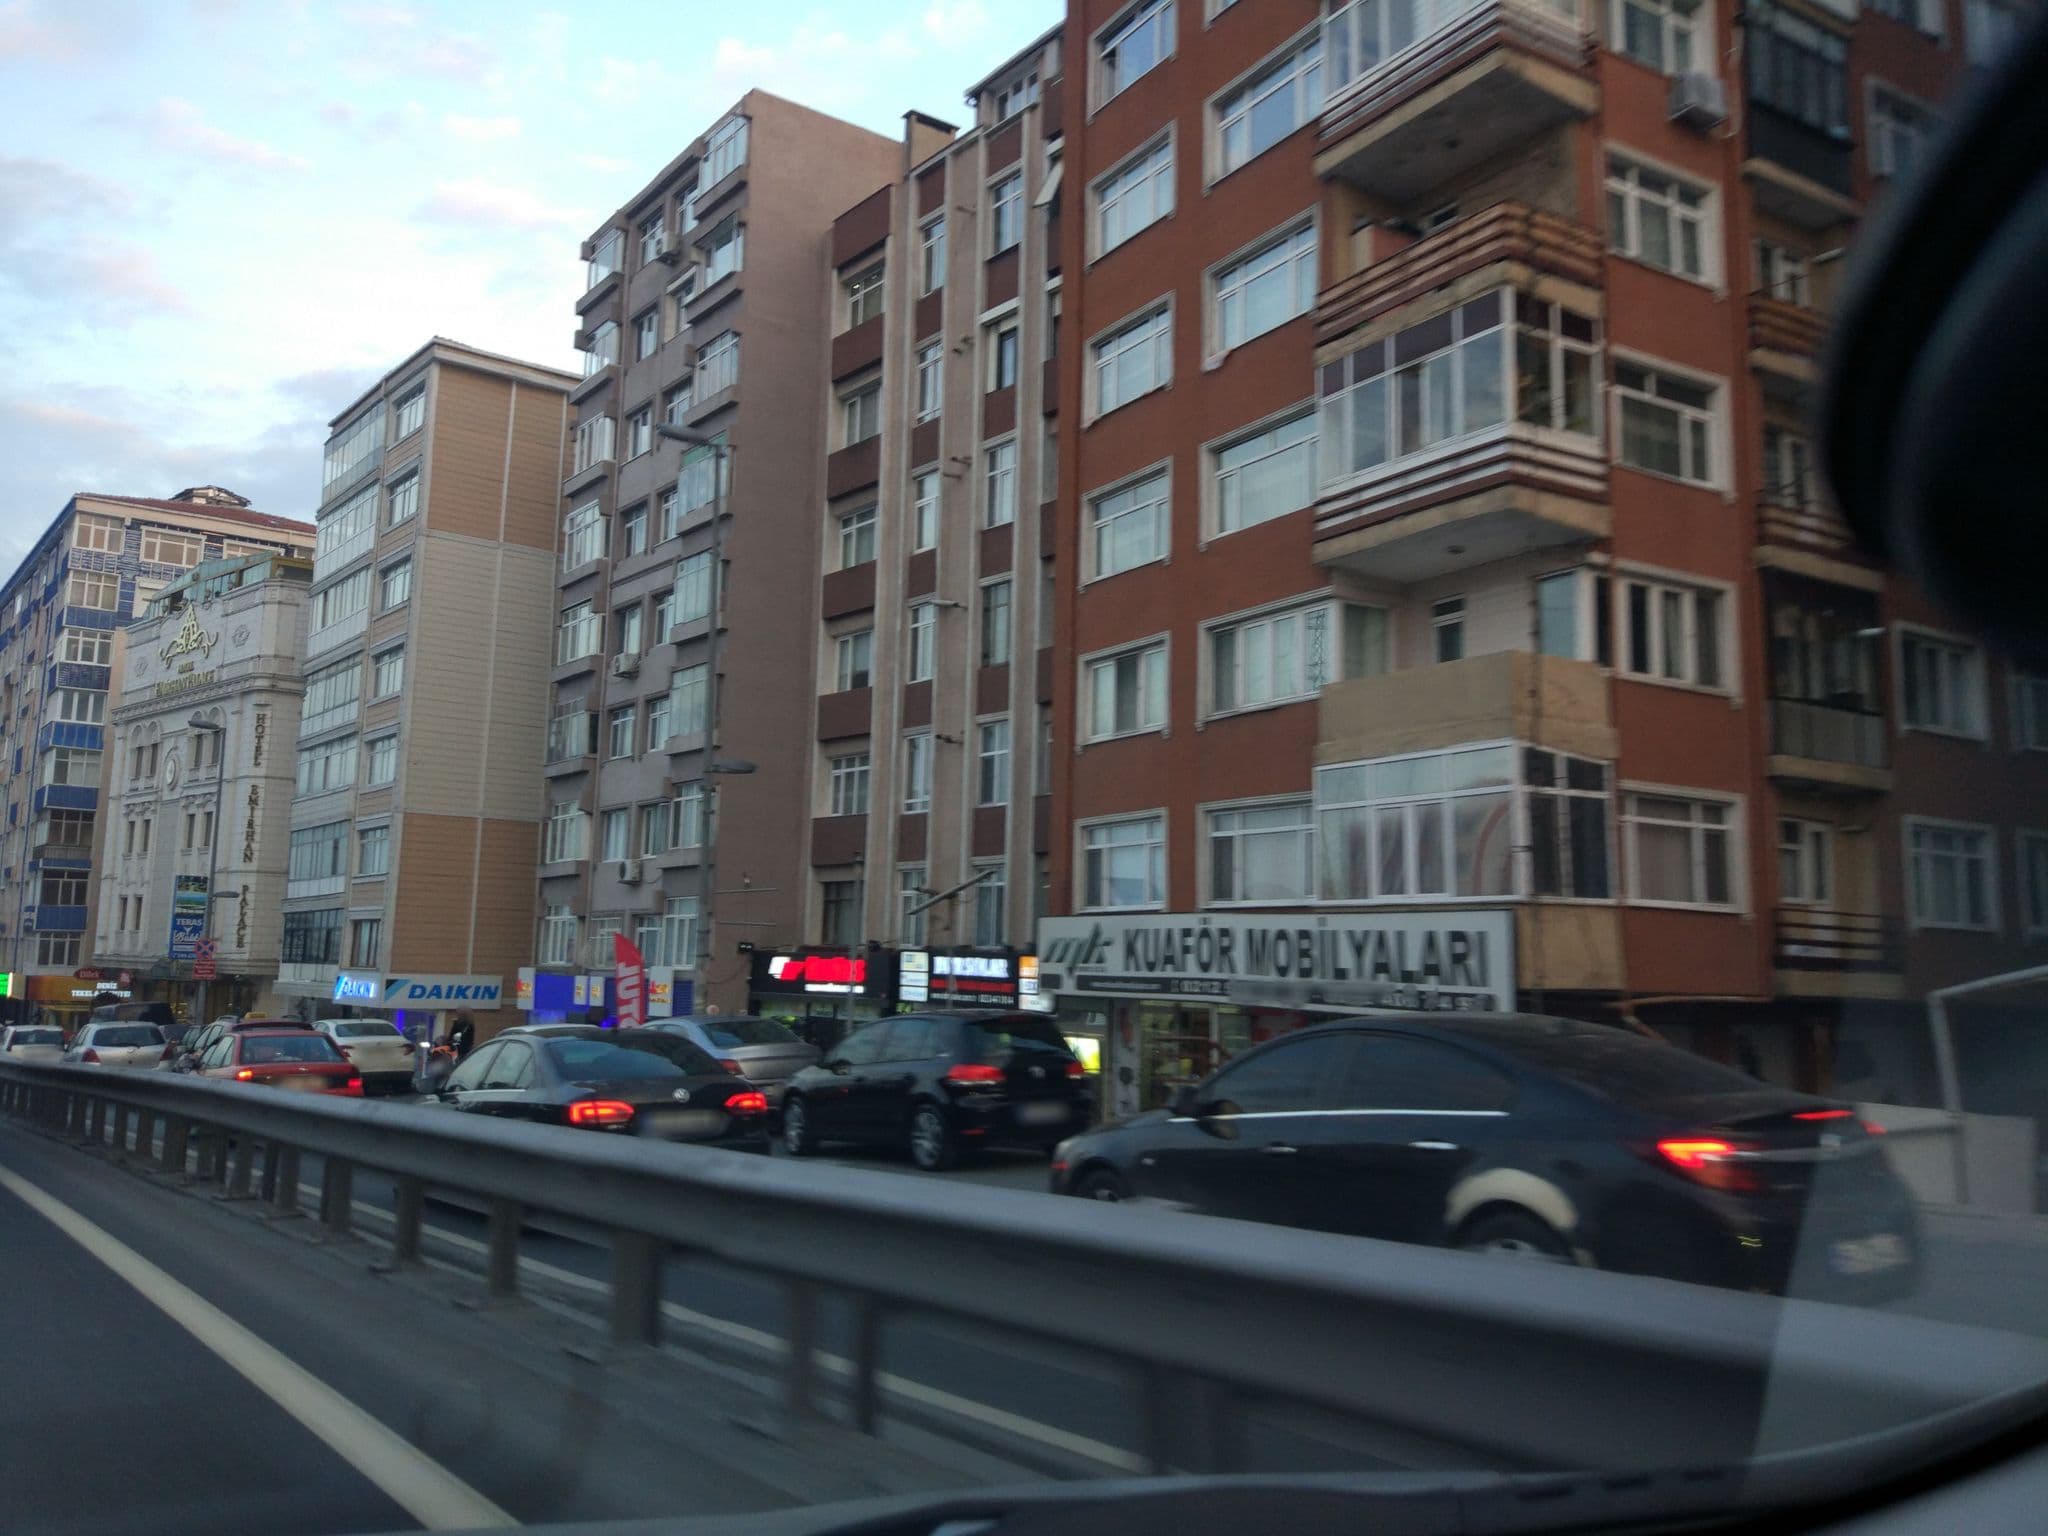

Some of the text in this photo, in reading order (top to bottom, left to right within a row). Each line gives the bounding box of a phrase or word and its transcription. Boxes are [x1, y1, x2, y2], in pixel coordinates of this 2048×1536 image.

[253, 712, 266, 767] HOTEL
[175, 917, 203, 927] TERAS
[236, 884, 250, 949] PALACE
[1122, 917, 1489, 988] KUAFÖR MOBİLYALARI
[407, 984, 499, 1001] DAIKIN
